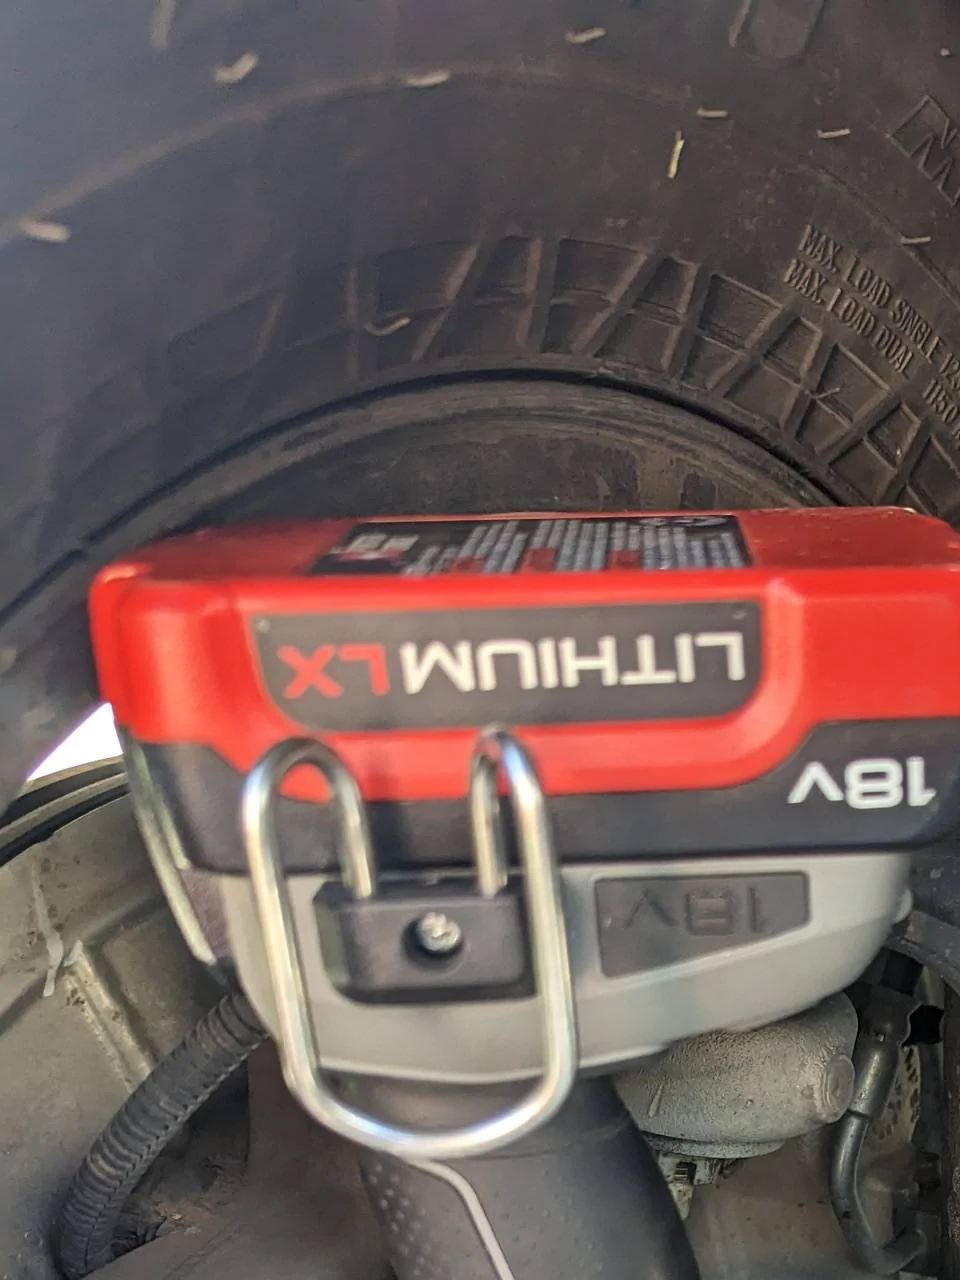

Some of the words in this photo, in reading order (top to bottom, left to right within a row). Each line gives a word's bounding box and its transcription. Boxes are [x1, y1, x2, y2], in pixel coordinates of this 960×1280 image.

[841, 254, 891, 310] LOAD
[892, 298, 947, 365] SINGLE
[826, 287, 878, 340] LOAD
[872, 324, 916, 379] DUAL
[921, 377, 959, 427] 1150
[277, 643, 390, 699] LX
[401, 631, 745, 695] LITHIUM
